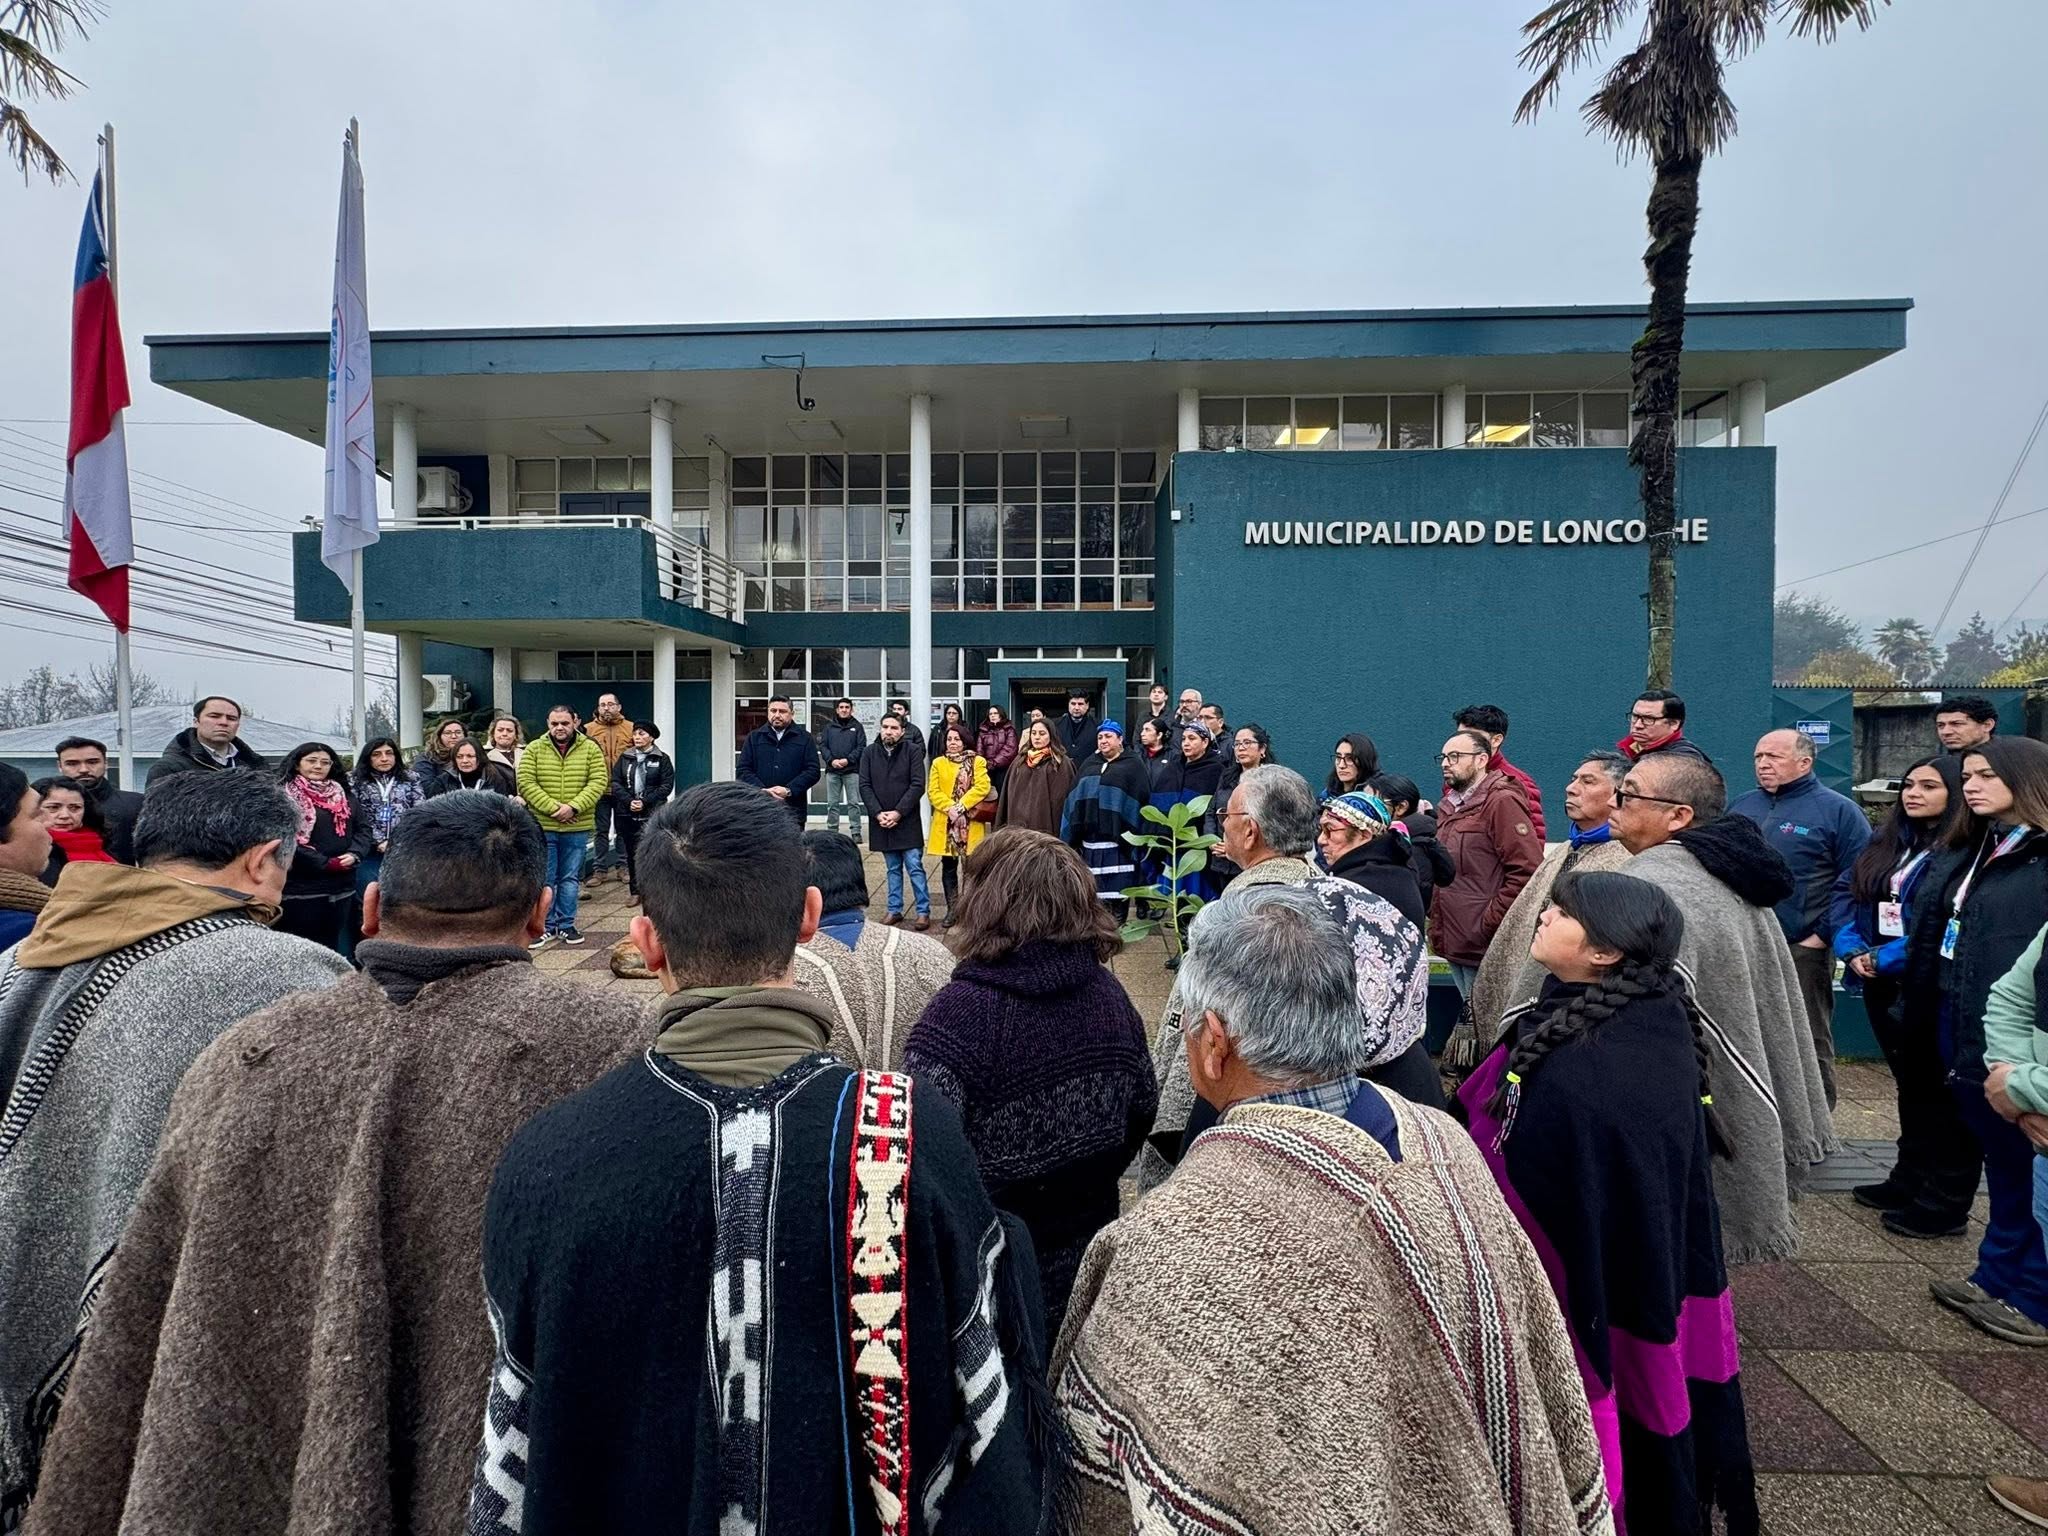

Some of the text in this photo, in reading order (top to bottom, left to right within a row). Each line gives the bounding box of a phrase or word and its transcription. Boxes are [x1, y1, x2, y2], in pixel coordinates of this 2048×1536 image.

[1244, 518, 1709, 545] MUNICIPALIDAD DE LONCOHE
